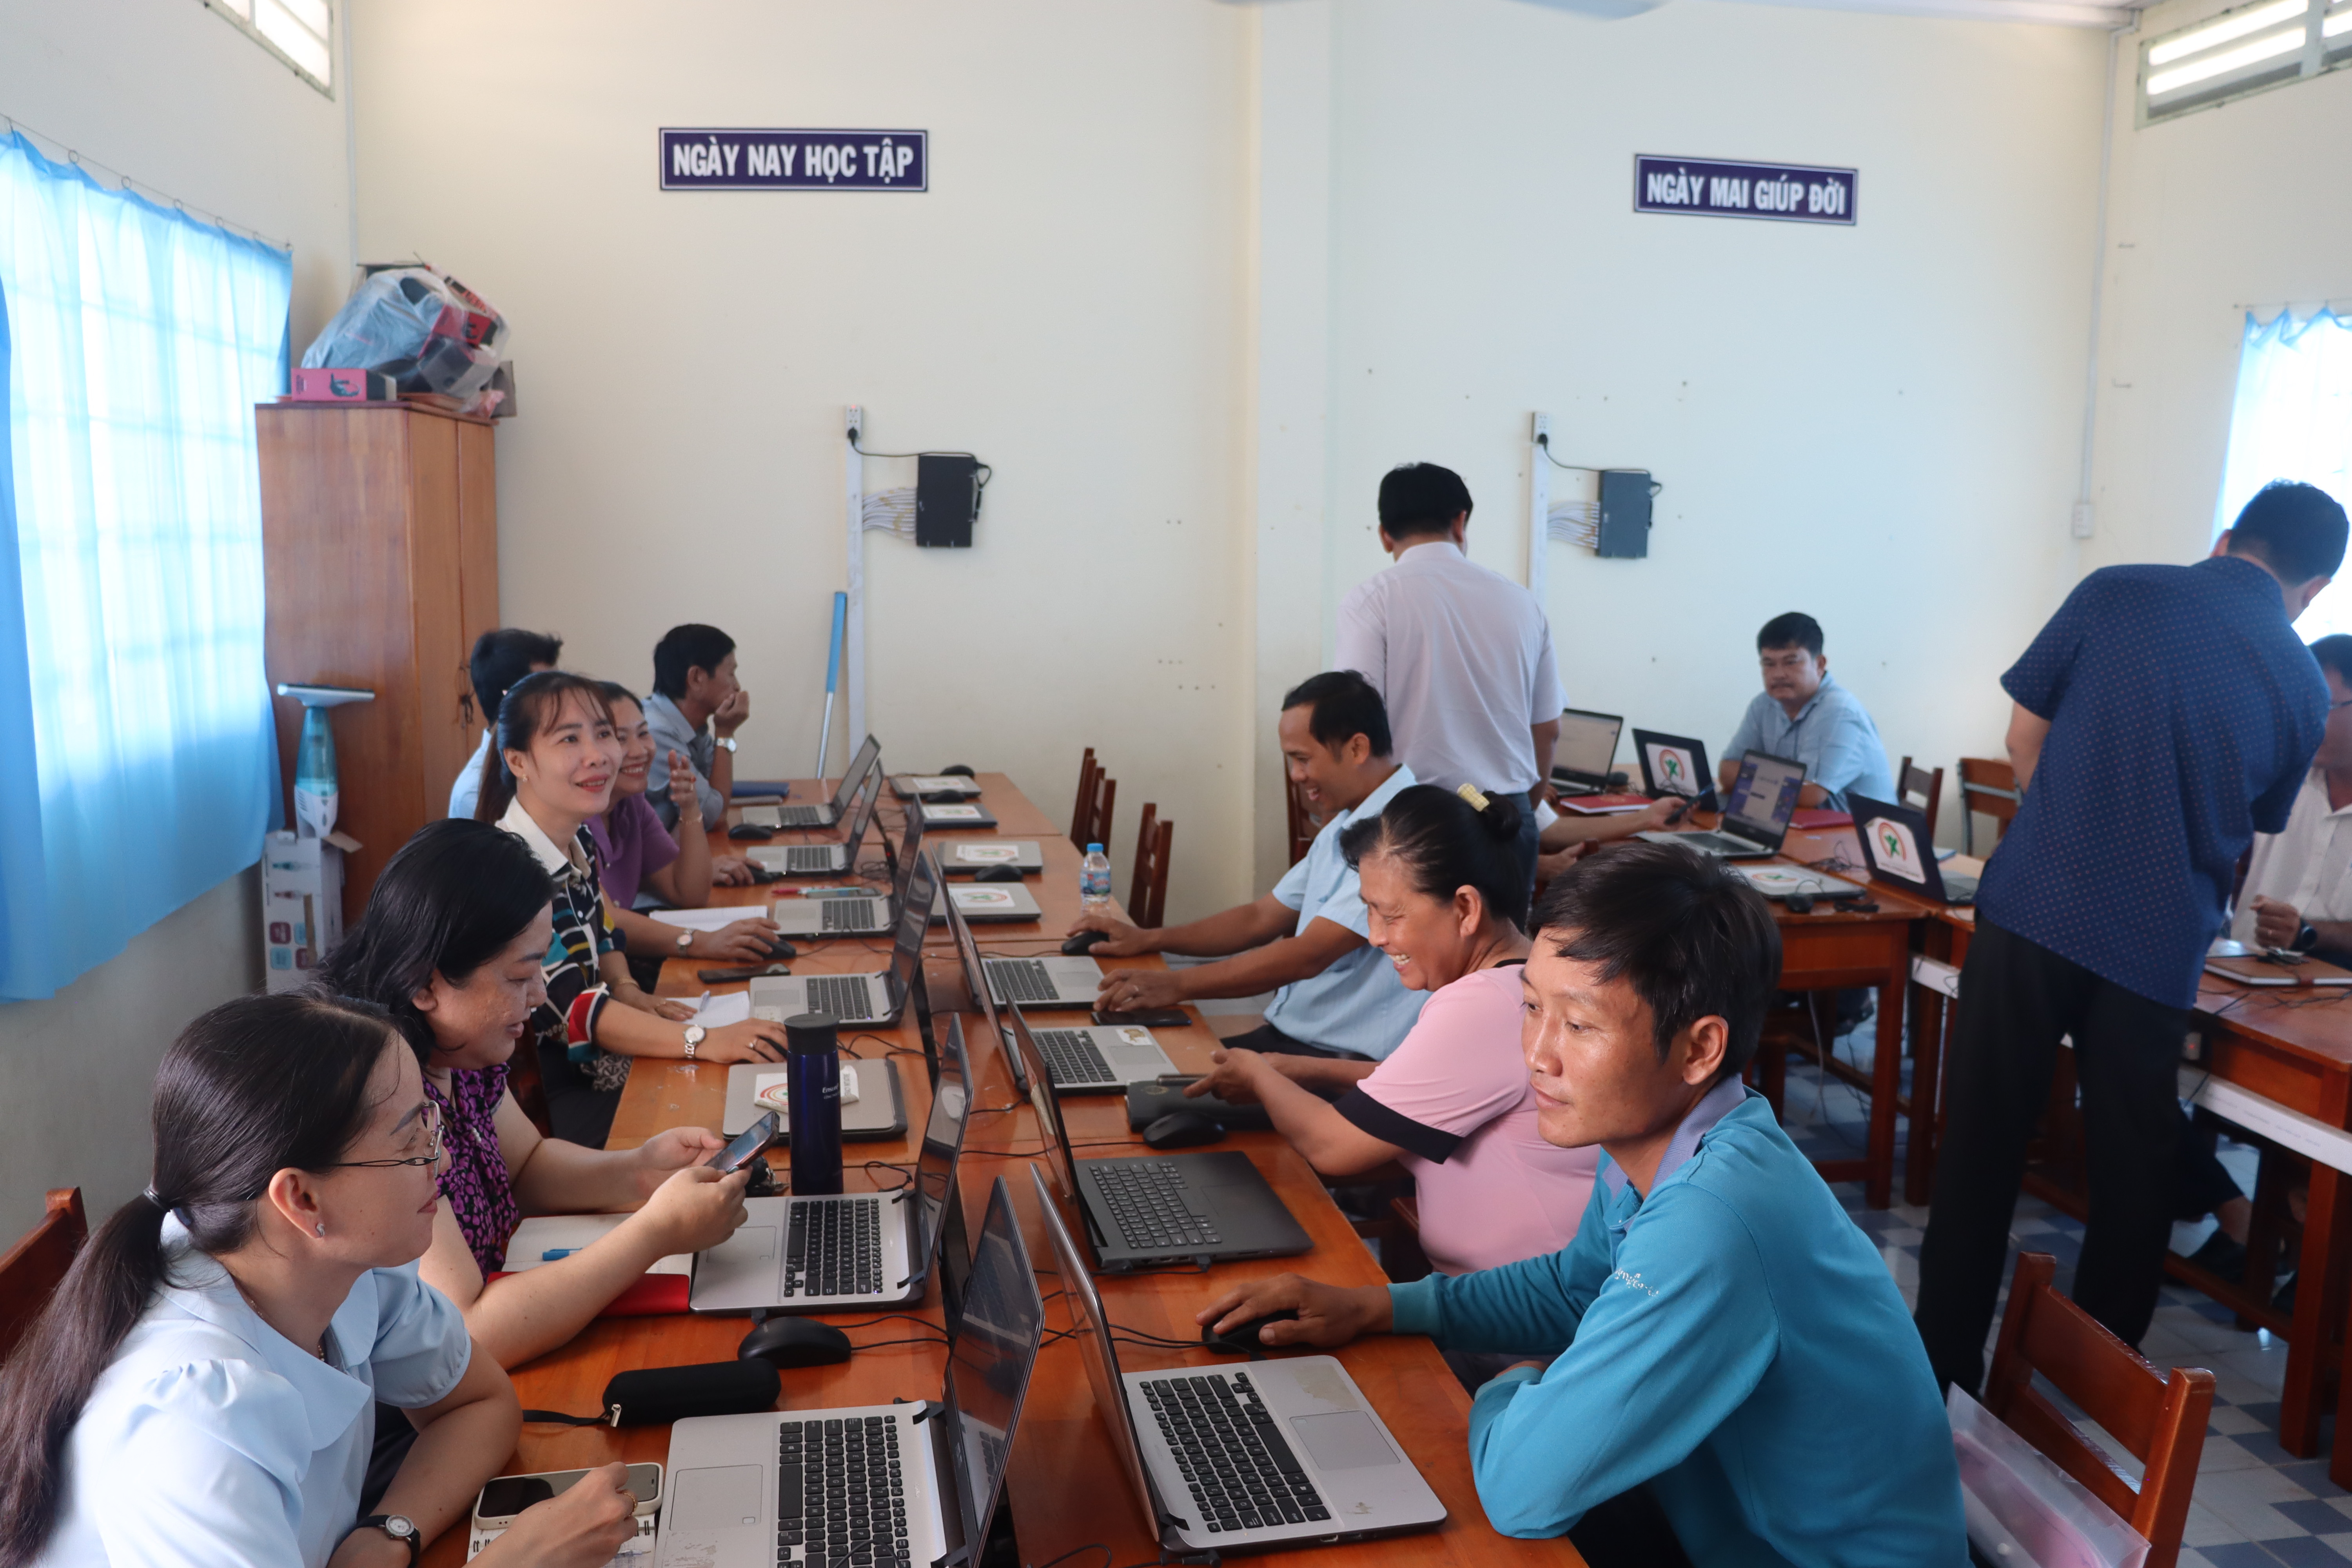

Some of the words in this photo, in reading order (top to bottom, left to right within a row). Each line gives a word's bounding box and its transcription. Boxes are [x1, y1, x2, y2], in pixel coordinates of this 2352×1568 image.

[673, 136, 739, 176] NGÀY
[748, 145, 797, 176] NAY
[806, 145, 856, 183] HỌC
[863, 138, 913, 183] TẬP
[1648, 167, 1704, 205] NGÀY
[1710, 177, 1749, 208] MAI
[1754, 174, 1804, 211] GIÚP
[1809, 178, 1845, 214] ĐỜI
